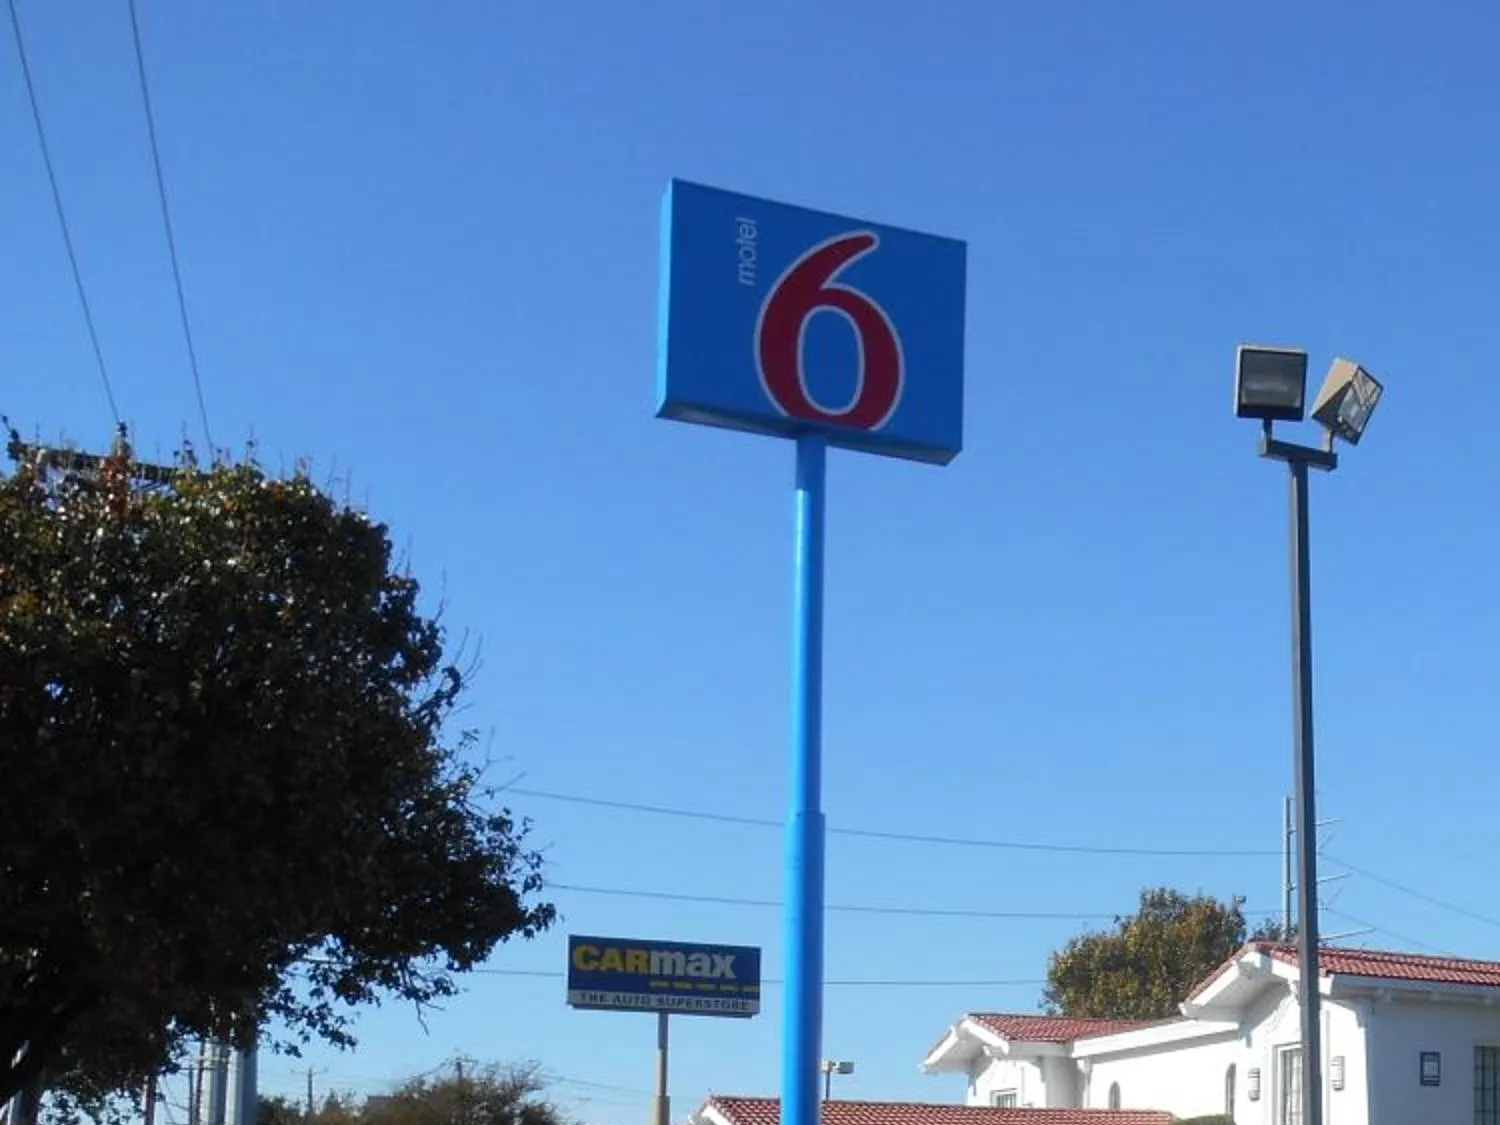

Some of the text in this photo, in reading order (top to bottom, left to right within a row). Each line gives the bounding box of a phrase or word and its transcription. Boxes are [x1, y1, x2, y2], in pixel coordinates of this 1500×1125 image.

[735, 217, 757, 286] motel
[754, 229, 905, 432] 6
[580, 992, 749, 1010] THE AUTO SUPERSTORE
